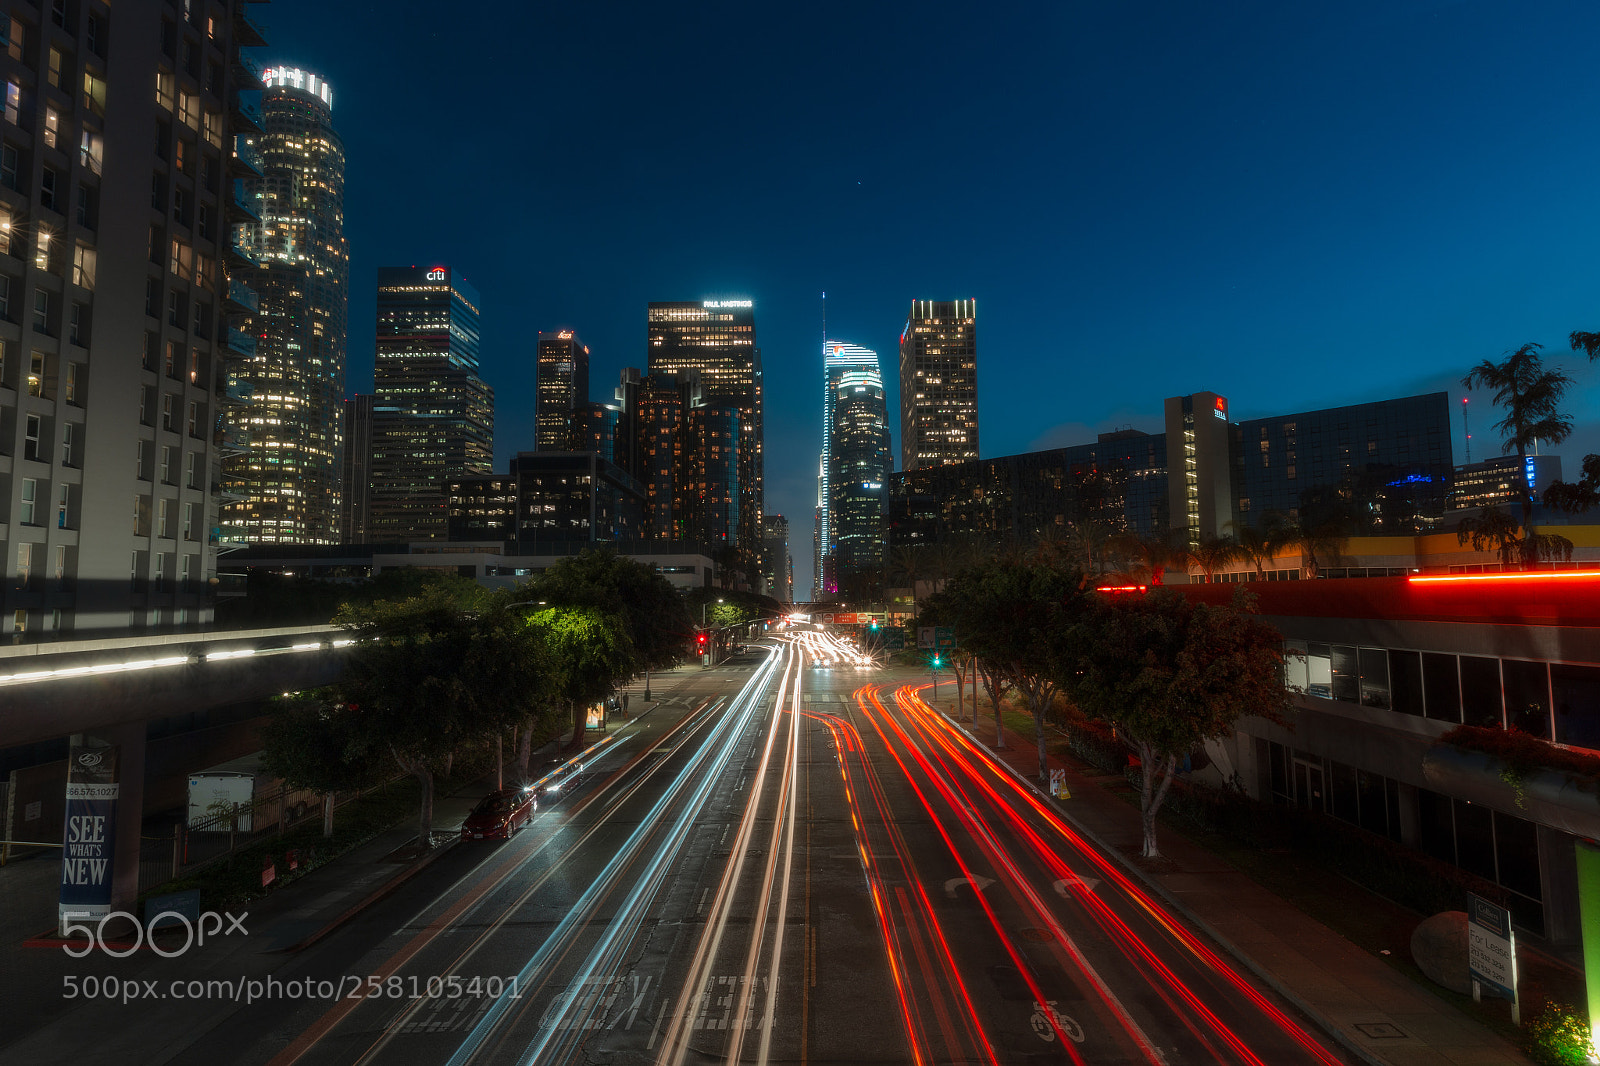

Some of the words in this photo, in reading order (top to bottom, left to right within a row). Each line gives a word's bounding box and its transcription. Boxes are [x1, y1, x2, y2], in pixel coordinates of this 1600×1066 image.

[426, 268, 445, 281] citi
[703, 300, 720, 308] PAUL
[68, 815, 105, 843] SEE
[69, 844, 102, 857] WHAT'S
[63, 858, 108, 885] NEW
[1470, 929, 1484, 943] For
[1485, 938, 1509, 960] Lease
